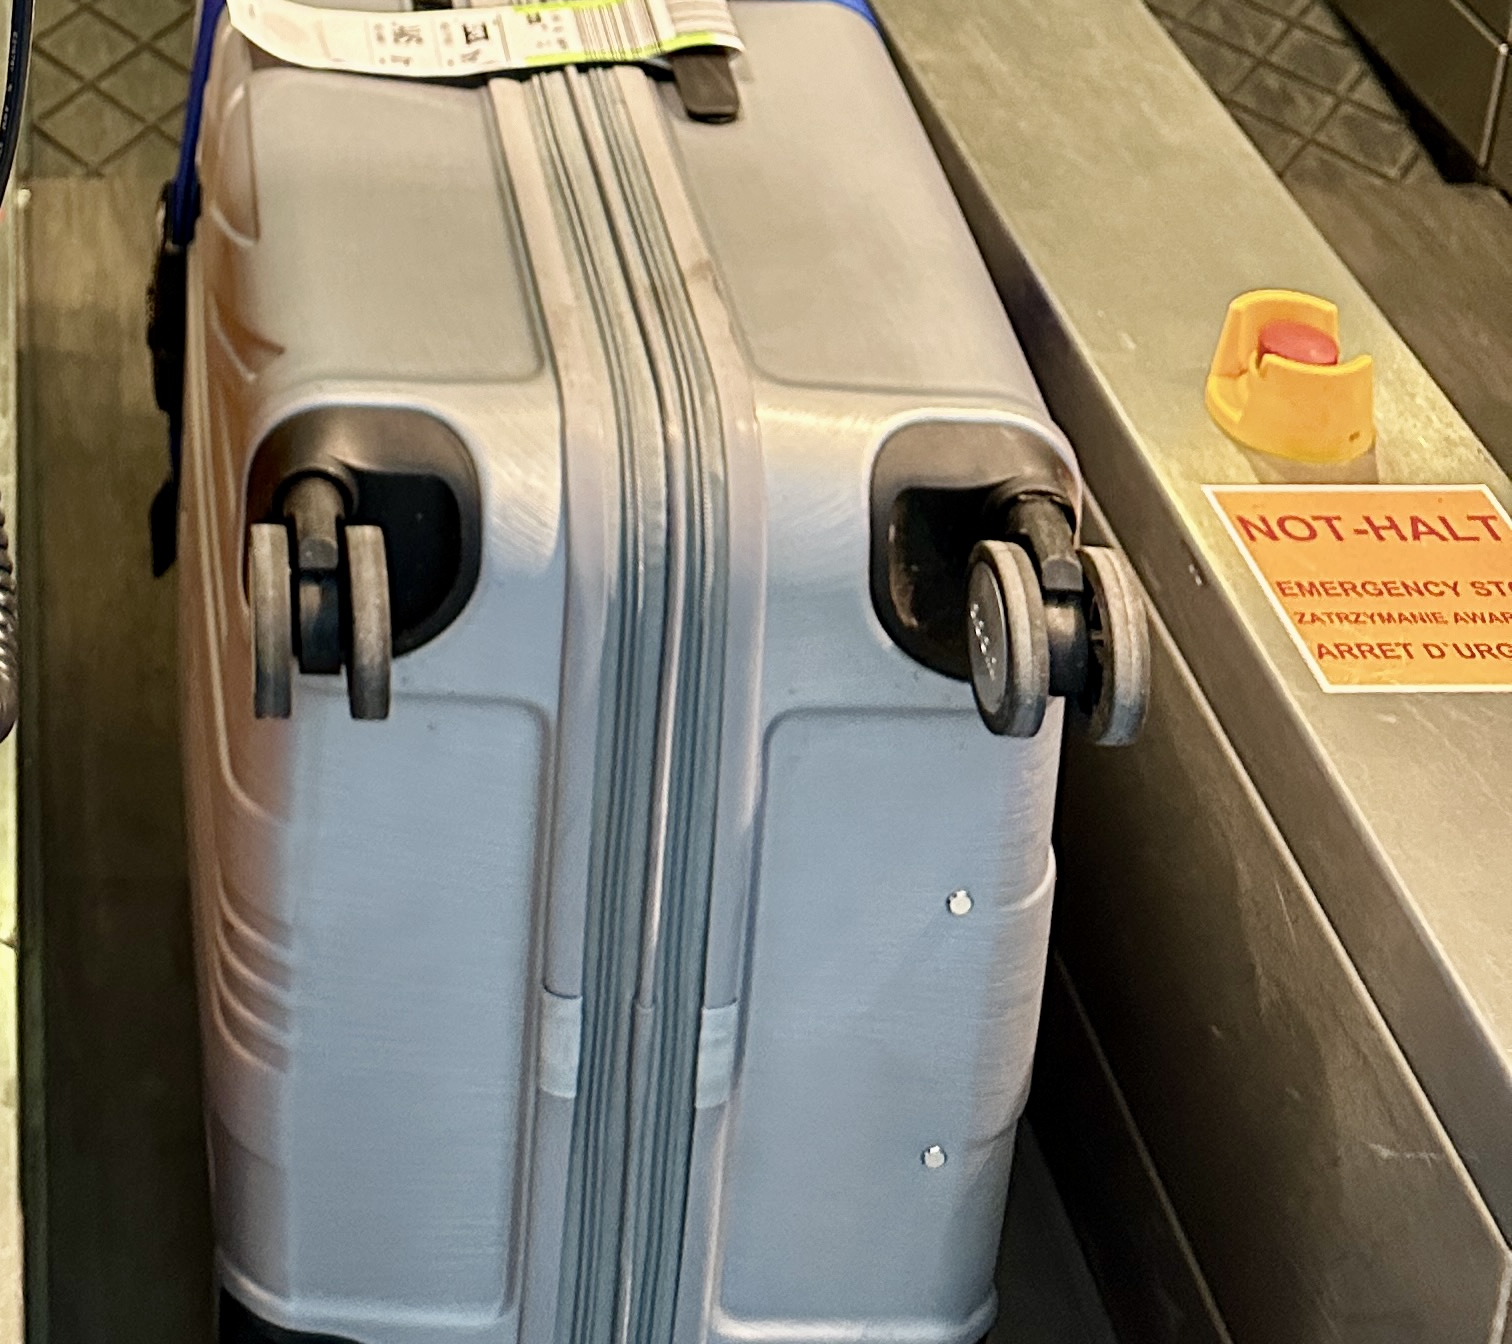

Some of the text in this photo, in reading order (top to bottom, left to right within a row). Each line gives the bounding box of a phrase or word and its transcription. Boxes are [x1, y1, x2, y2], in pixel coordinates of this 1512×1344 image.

[1236, 515, 1502, 542] NOT-HALT
[1275, 580, 1512, 598] EMERGENCY ST
[1317, 642, 1415, 660] ARRET
